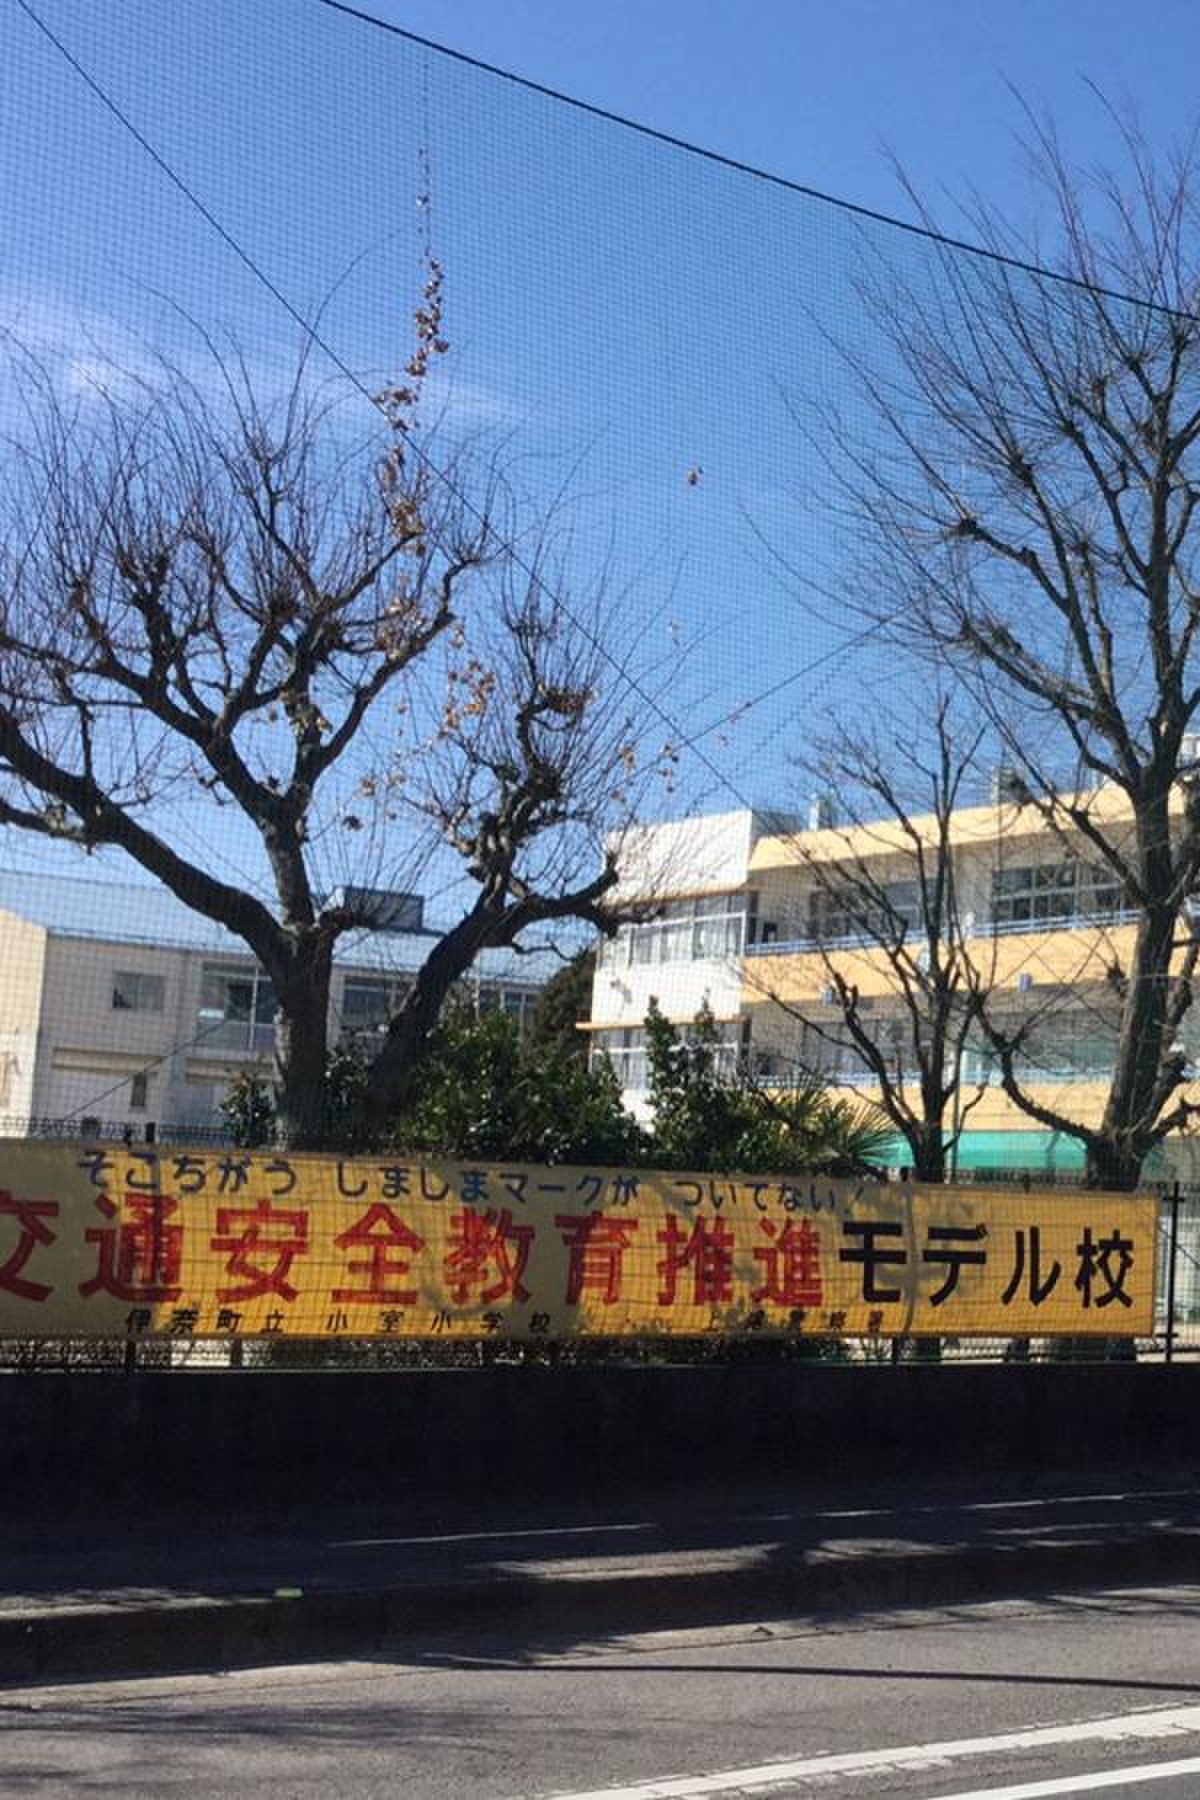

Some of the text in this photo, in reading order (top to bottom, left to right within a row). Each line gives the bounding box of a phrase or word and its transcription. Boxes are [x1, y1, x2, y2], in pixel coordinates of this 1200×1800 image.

[337, 1160, 641, 1206] しましまマークが
